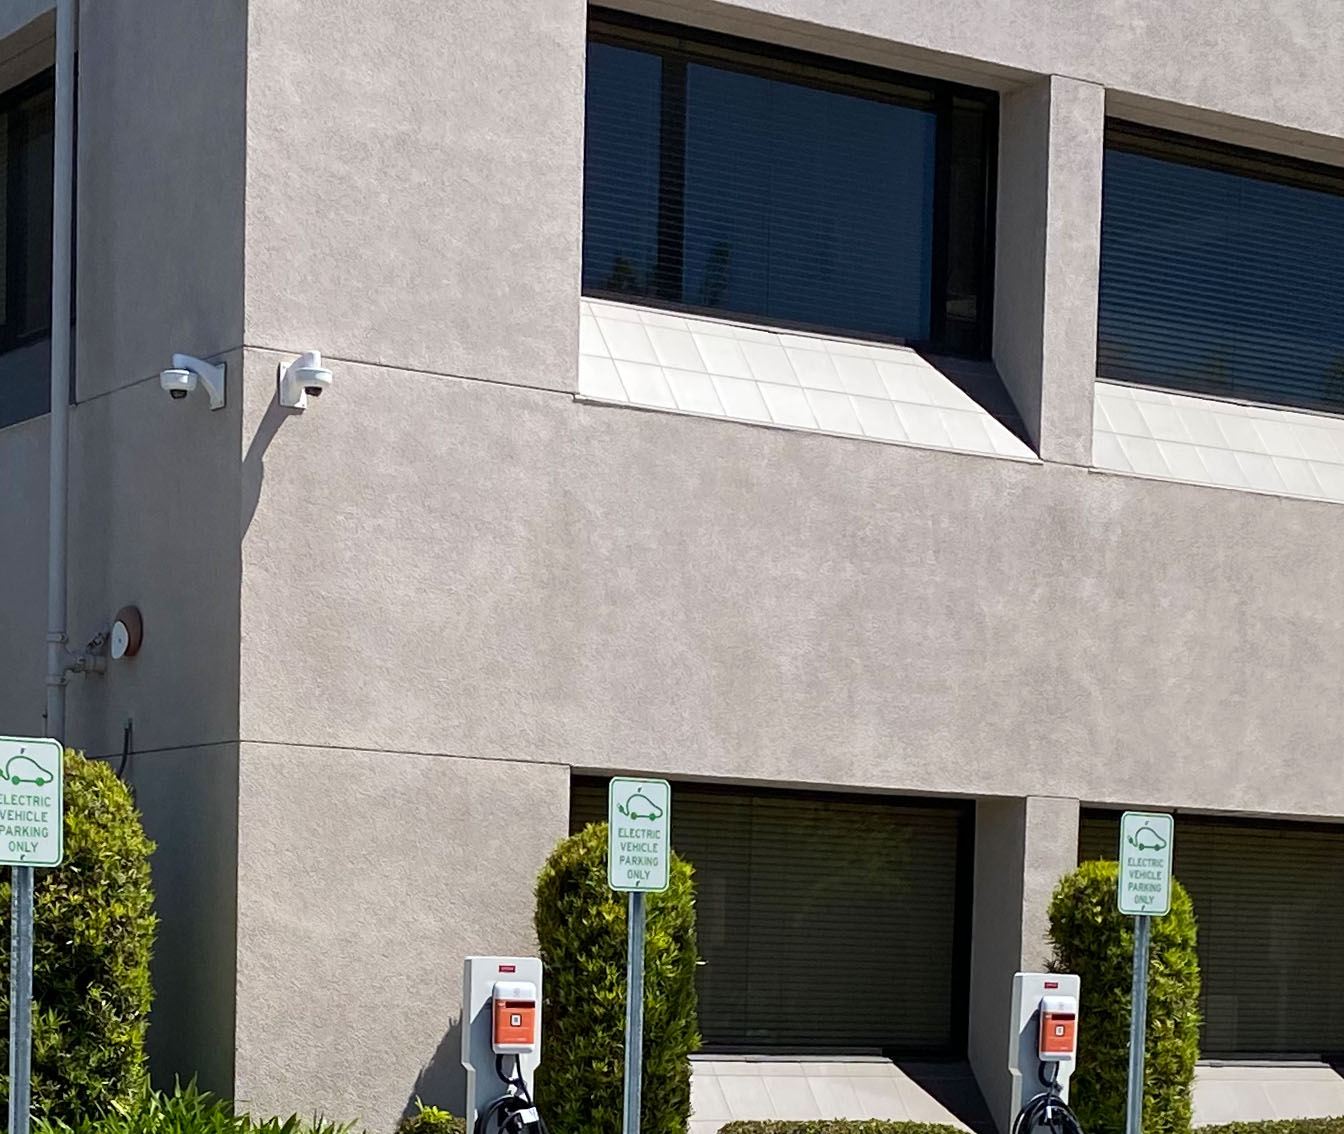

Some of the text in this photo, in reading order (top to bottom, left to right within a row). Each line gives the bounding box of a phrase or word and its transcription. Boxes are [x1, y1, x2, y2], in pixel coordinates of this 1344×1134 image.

[617, 827, 661, 839] ELECTRIC
[8, 840, 39, 853] ONLY
[620, 841, 659, 853] VEHICLE
[619, 855, 659, 867] PARKING
[1127, 857, 1164, 868] ELECTRIC
[626, 869, 652, 880] ONLY
[1128, 869, 1162, 880] VEHICLE
[1127, 882, 1162, 892] PARKING
